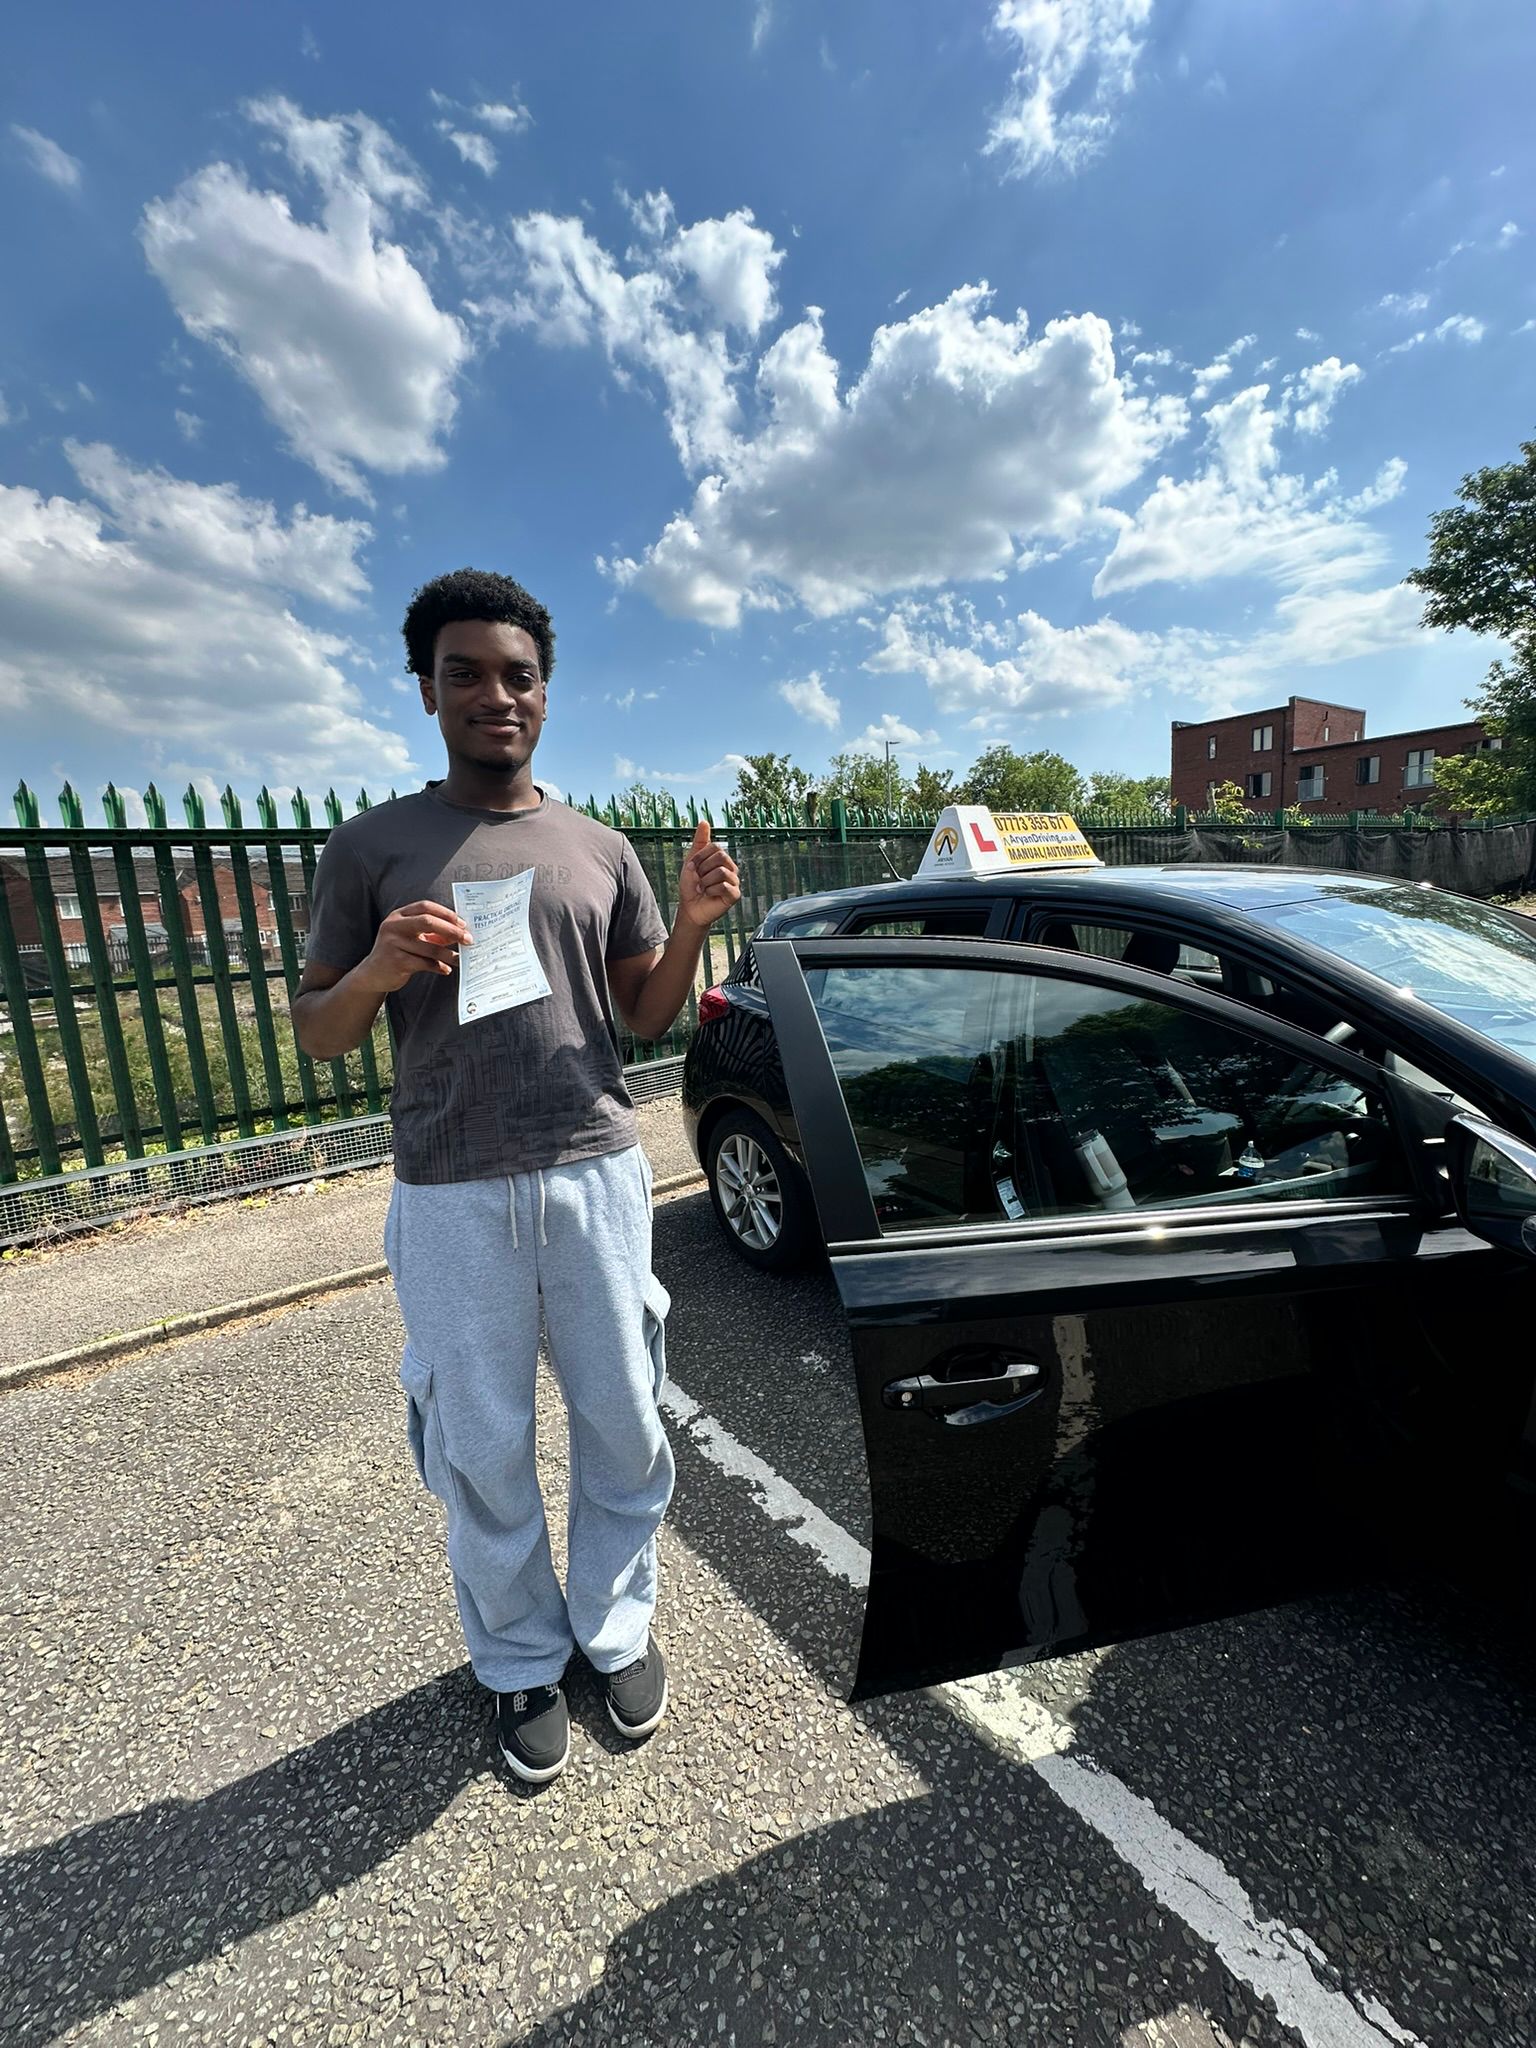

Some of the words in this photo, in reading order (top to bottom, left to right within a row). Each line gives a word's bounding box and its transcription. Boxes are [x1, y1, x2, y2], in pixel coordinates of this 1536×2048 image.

[994, 817, 1028, 831] 07773
[1028, 817, 1048, 830] 355
[1049, 816, 1068, 829] 671
[970, 823, 998, 852] L
[1009, 832, 1077, 846] AryanDriving.co.uk
[1008, 845, 1090, 860] MANUAL/AUTOMATIC
[474, 909, 503, 922] PRACTICAL
